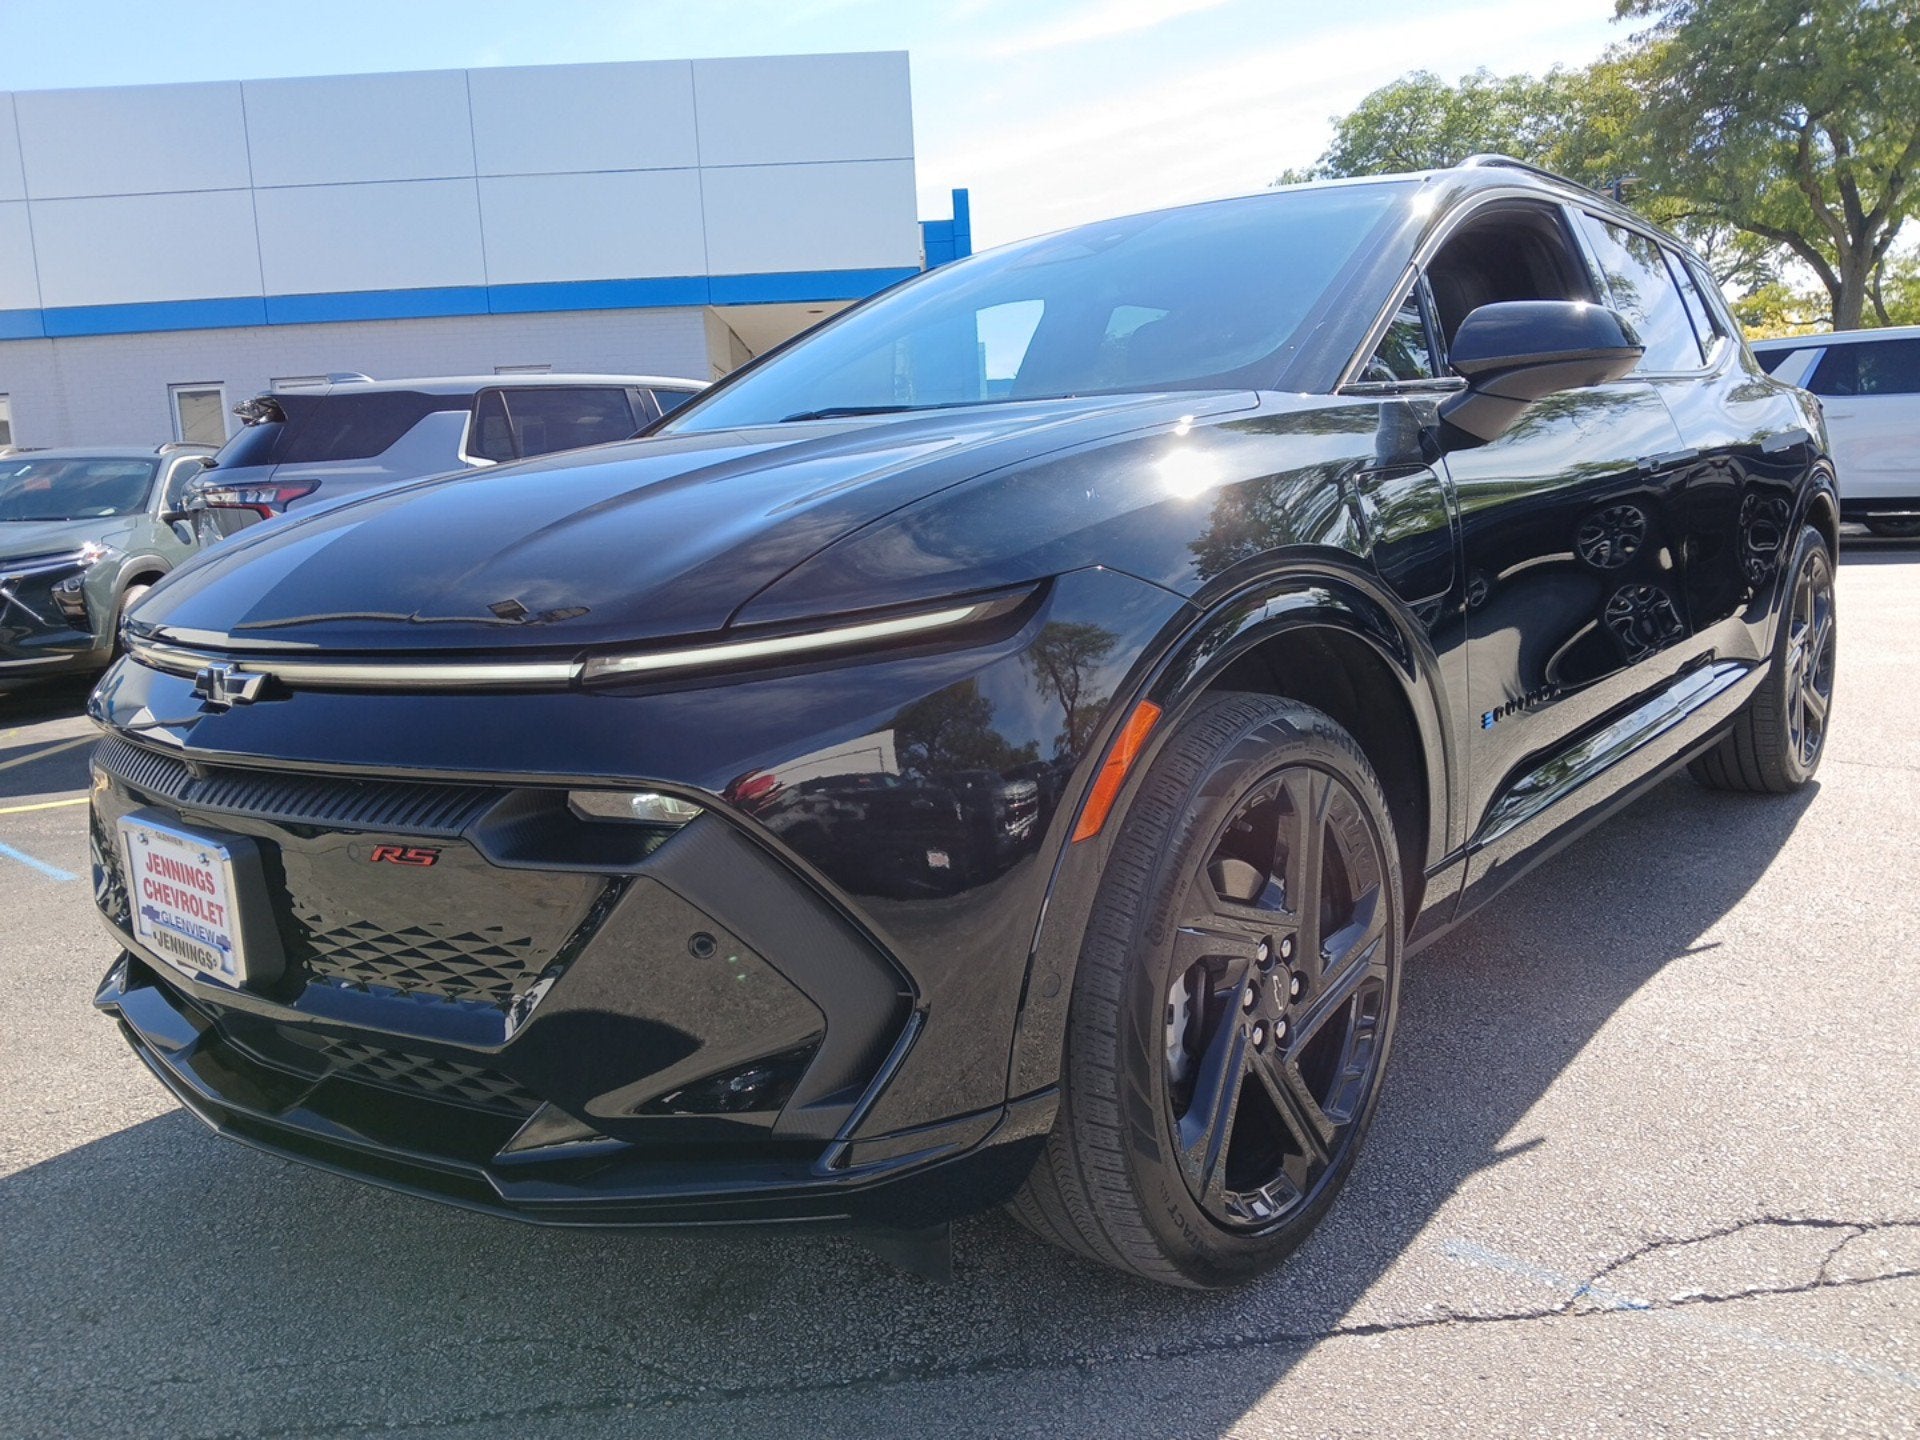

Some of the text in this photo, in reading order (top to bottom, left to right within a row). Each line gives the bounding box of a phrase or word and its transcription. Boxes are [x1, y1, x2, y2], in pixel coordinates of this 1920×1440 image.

[146, 852, 216, 896] JENNINGS
[370, 844, 442, 868] RS
[143, 877, 224, 928] CHEVROLET
[160, 910, 217, 944] GLENVIEW
[156, 931, 215, 970] JENNINGS
